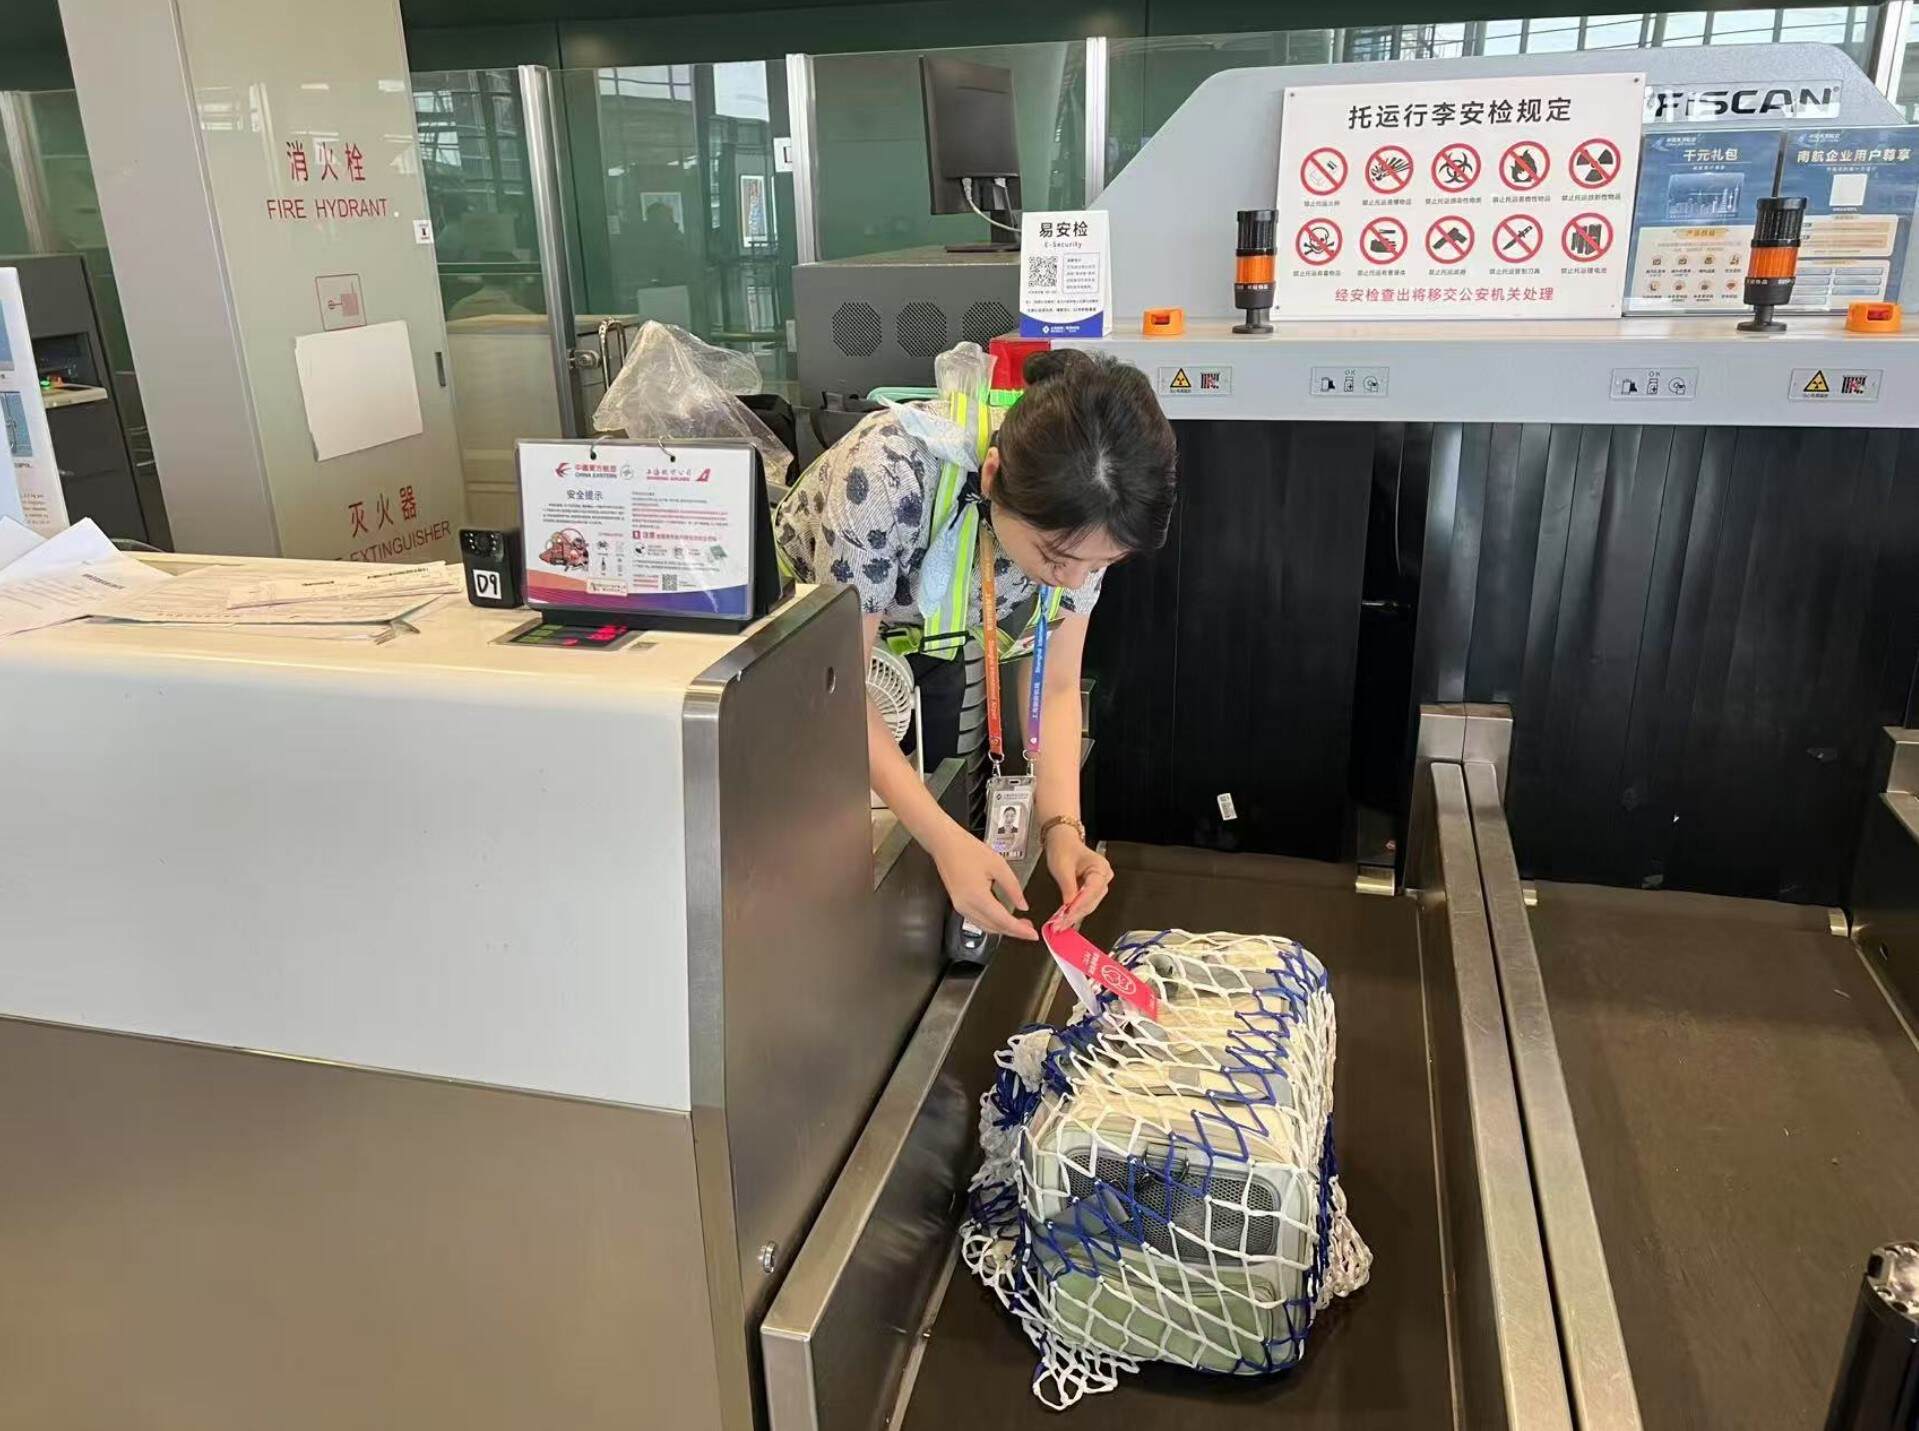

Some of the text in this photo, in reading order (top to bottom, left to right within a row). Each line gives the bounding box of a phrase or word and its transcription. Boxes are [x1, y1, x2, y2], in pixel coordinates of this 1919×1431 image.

[1348, 97, 1572, 130] 托运行李安检规定
[286, 140, 366, 182] 消火栓
[1682, 148, 1738, 162] 千元礼包
[1797, 148, 1912, 164] 南航企业用户尊享
[266, 198, 388, 220] FIRE HYDRANT
[1039, 220, 1088, 238] 易安检
[1334, 286, 1554, 302] 经安检查出将移交公安机关处理
[566, 489, 604, 501] 安全提示
[348, 485, 417, 538] 灭火器
[350, 520, 451, 562] EXTINGUISHER
[477, 573, 498, 596] D9
